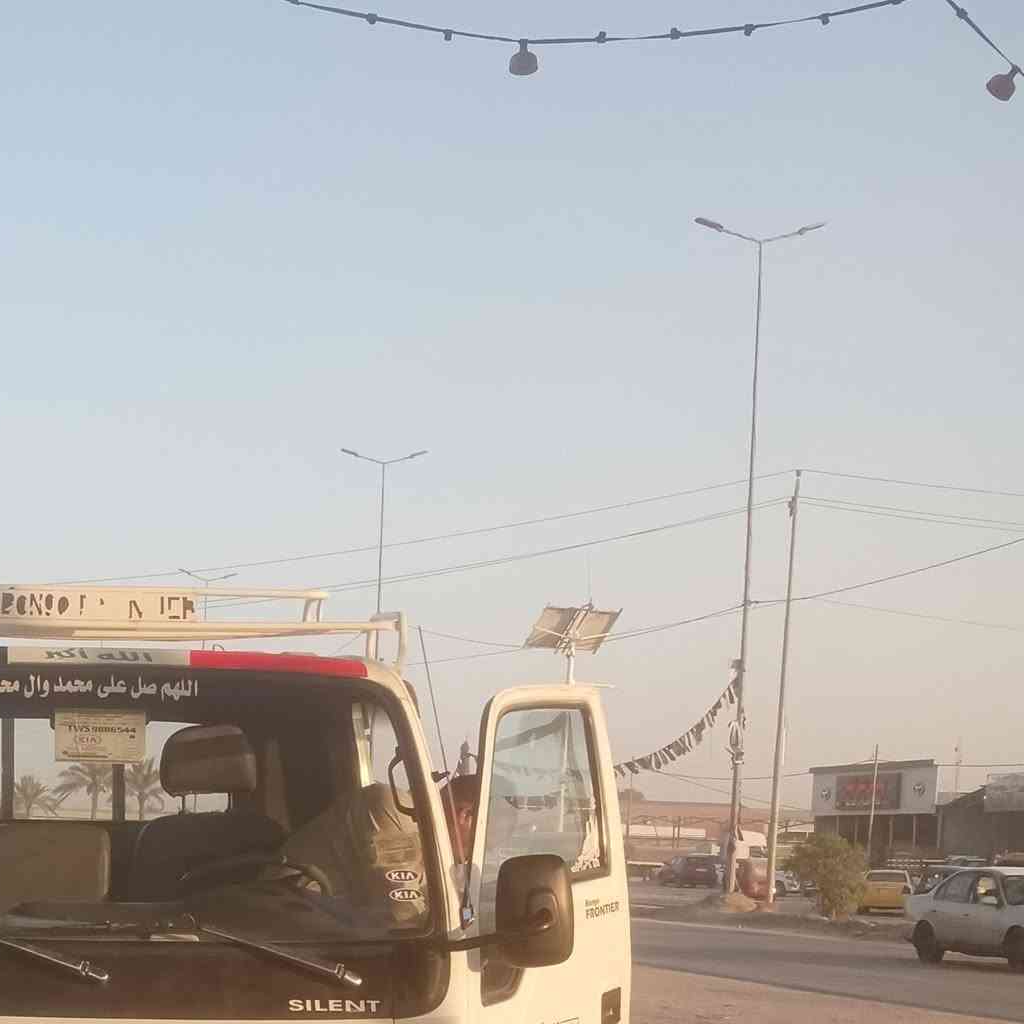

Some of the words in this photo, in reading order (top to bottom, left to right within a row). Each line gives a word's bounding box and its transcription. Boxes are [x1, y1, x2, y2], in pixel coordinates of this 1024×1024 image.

[23, 674, 49, 698] وال
[53, 675, 93, 693] محمد
[97, 675, 127, 698] على
[130, 675, 157, 698] صل
[160, 677, 198, 701] اللهم
[584, 901, 619, 920] FRONTIER
[288, 999, 380, 1013] SILENT
